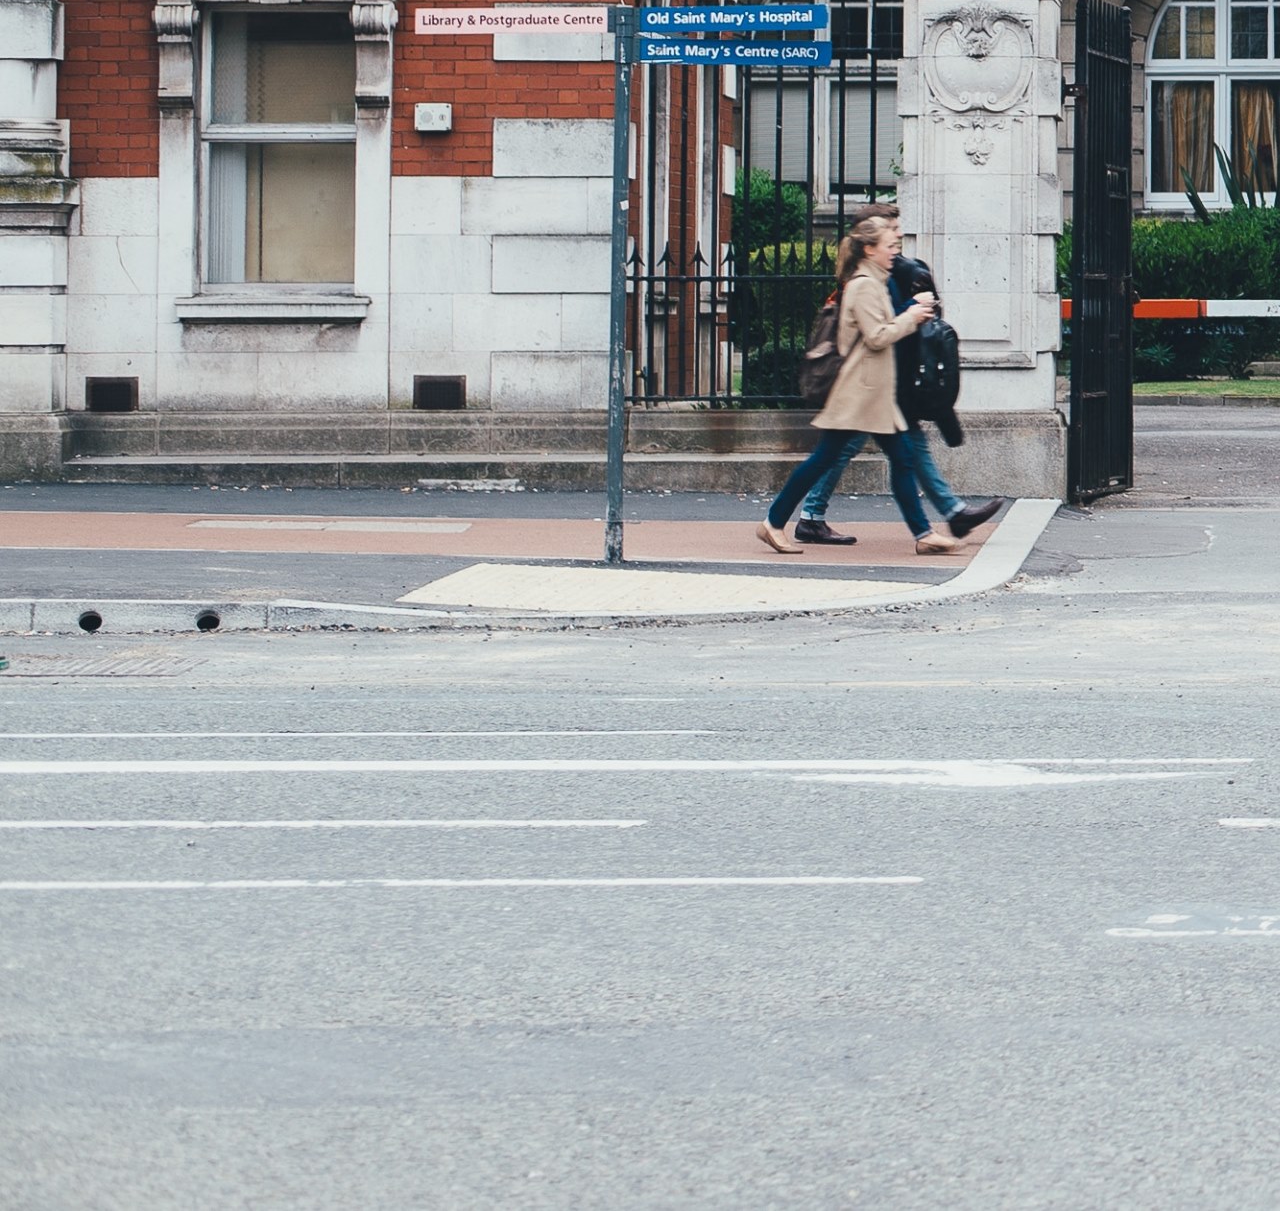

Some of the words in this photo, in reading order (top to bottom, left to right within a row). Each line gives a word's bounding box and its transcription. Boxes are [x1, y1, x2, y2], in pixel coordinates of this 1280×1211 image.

[422, 15, 464, 28] Library
[467, 16, 476, 26] &
[479, 14, 560, 29] Postgraduate
[564, 13, 604, 26] Centre
[647, 12, 669, 25] Old
[673, 11, 706, 24] Saint
[710, 11, 755, 26] Mary's
[759, 10, 813, 26] Hospital
[647, 44, 681, 57] Saint
[685, 45, 731, 60] Mary's
[735, 46, 779, 58] Centre
[781, 48, 819, 59] (SARC)
